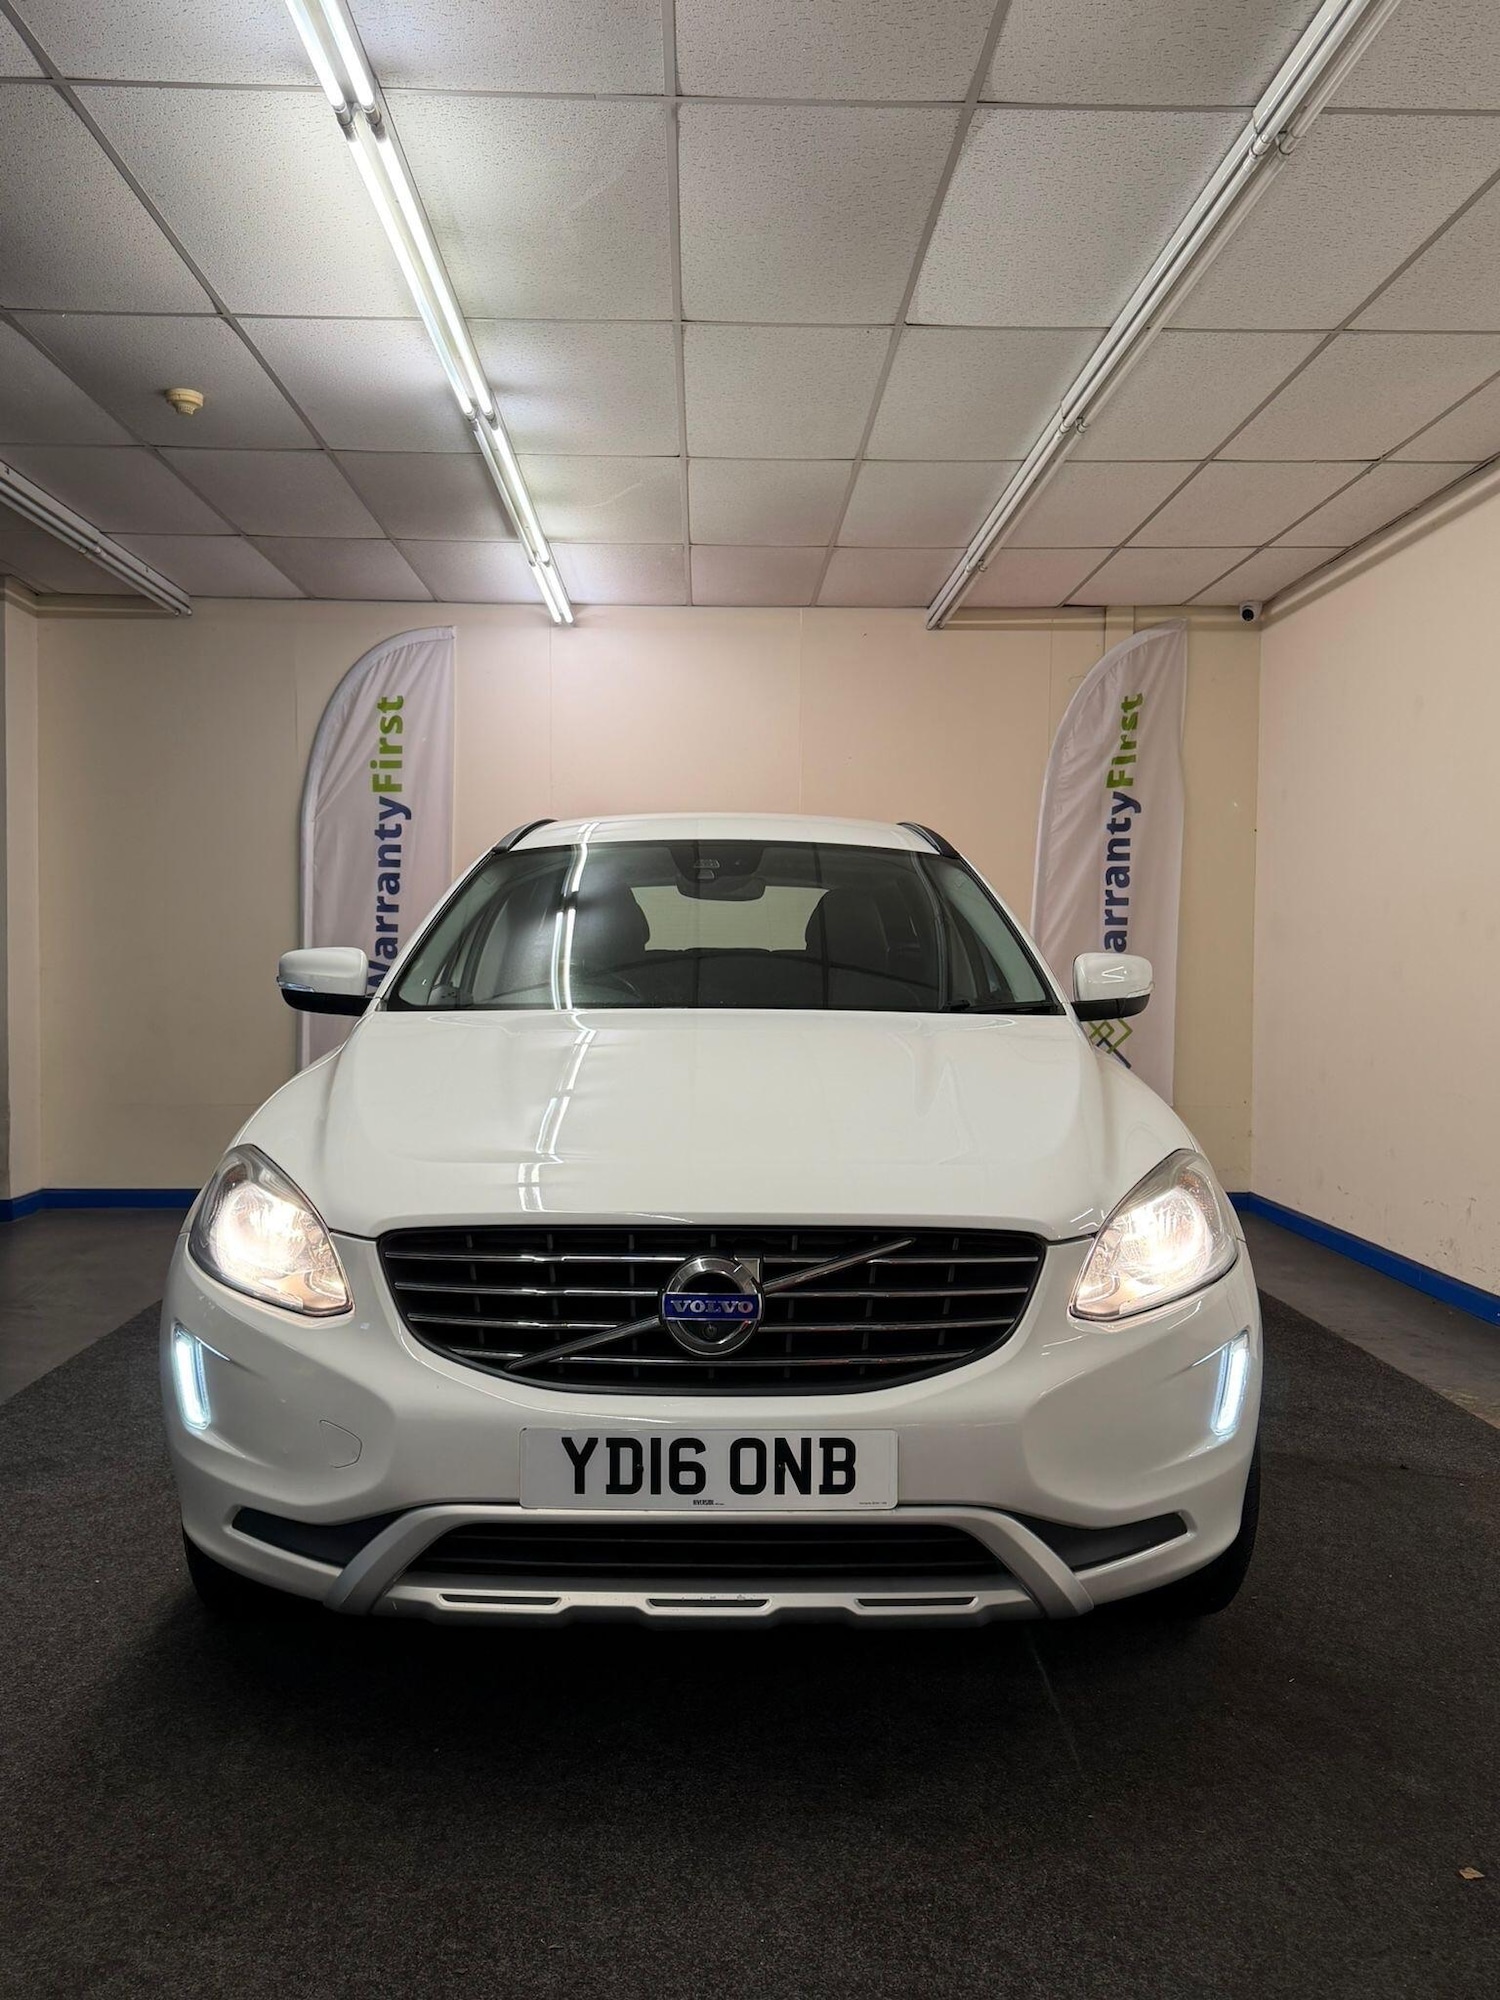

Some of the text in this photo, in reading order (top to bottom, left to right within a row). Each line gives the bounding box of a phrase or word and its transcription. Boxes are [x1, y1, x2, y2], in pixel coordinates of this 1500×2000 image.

[1103, 692, 1144, 953] arrantyFirst
[670, 1299, 754, 1313] VOLVO
[561, 1436, 857, 1495] YD16 ONB
